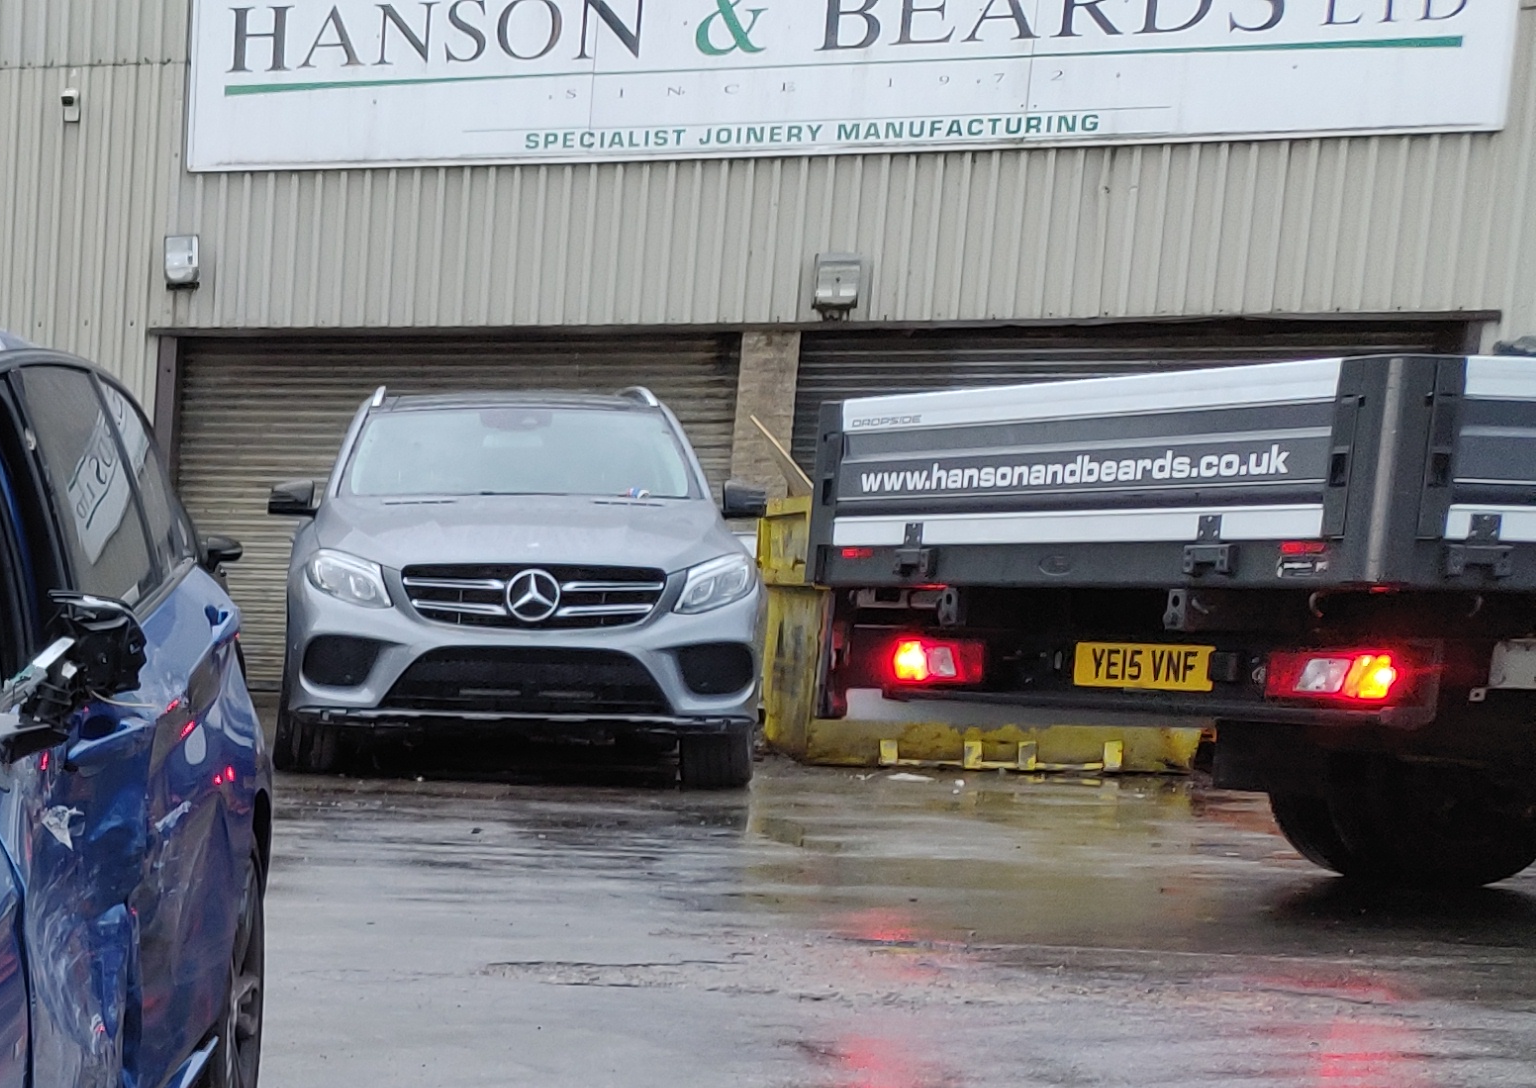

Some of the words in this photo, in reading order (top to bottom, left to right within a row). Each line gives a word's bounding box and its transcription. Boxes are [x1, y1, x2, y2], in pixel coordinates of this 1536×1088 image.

[225, 0, 644, 73] HANSON
[695, 0, 767, 56] &
[814, 0, 1286, 52] BEARDS
[525, 128, 687, 150] SPECIALIST
[699, 124, 823, 146] JOINERY
[836, 113, 1101, 141] MANUFACTURING
[851, 414, 922, 428] DROPSIDE
[861, 444, 1290, 493] www.hansonandbeards.co.uk
[1092, 648, 1143, 681] YE15
[1151, 649, 1199, 683] VNF
